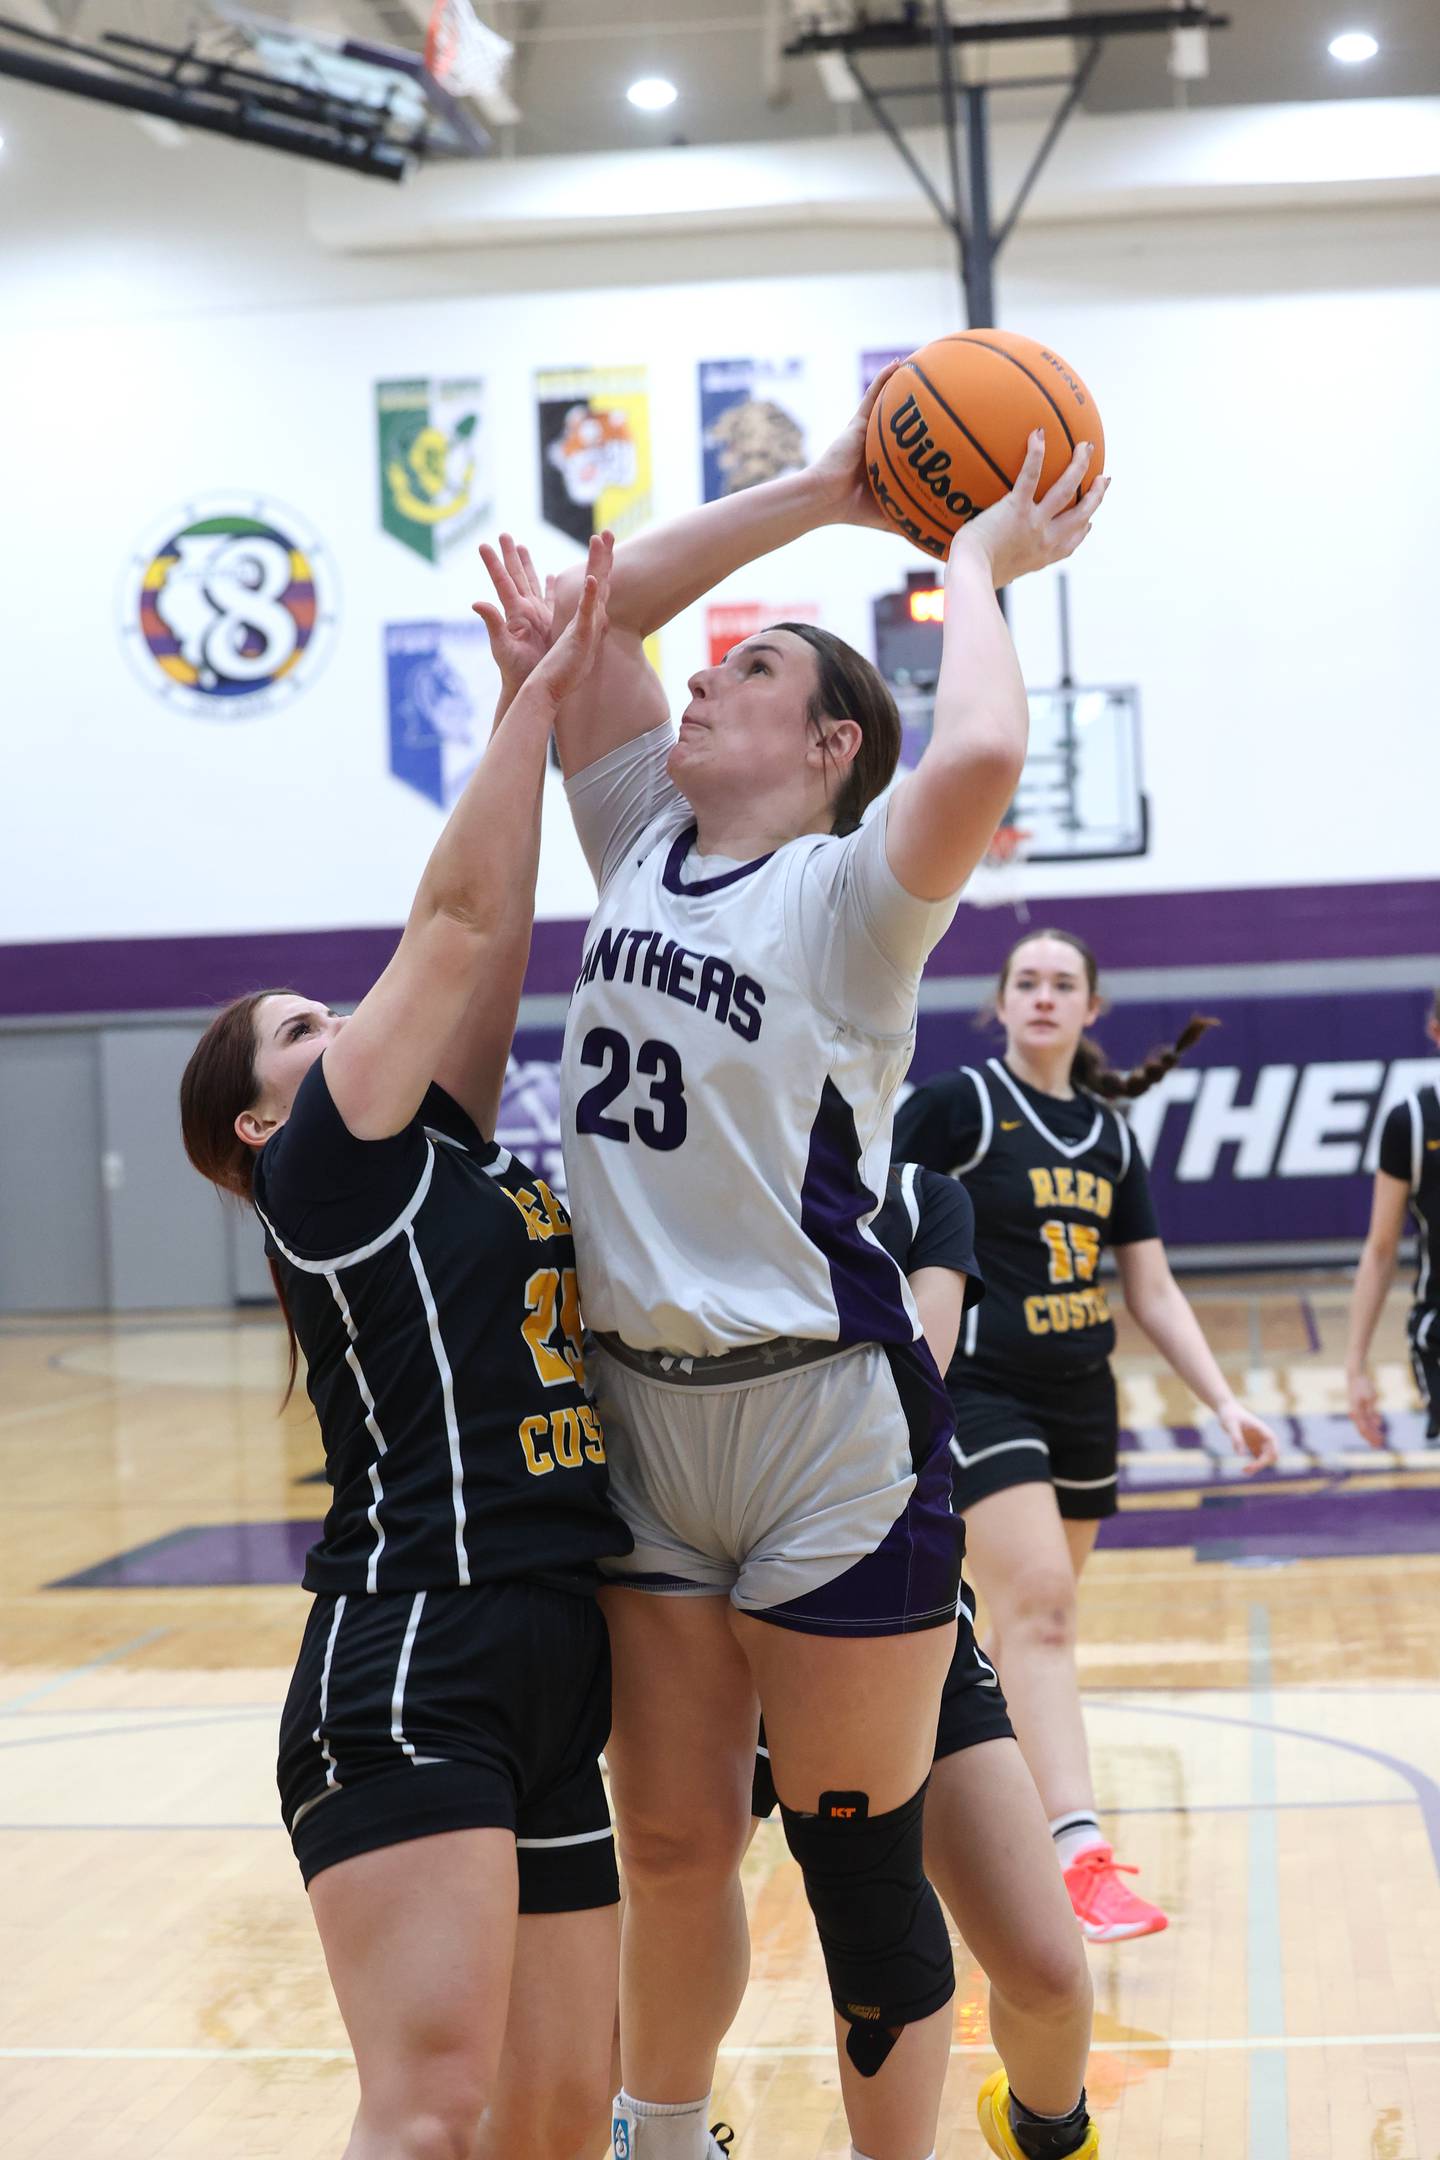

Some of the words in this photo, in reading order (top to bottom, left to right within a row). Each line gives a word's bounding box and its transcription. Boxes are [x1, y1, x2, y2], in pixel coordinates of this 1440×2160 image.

[568, 927, 766, 1043] ANTHERS
[576, 1026, 688, 1152] 23
[1028, 1166, 1113, 1219] REED
[1040, 1219, 1100, 1286] 15
[1023, 1286, 1109, 1335] CUST
[518, 1404, 606, 1476] CUS
[831, 1807, 856, 1818] KT
